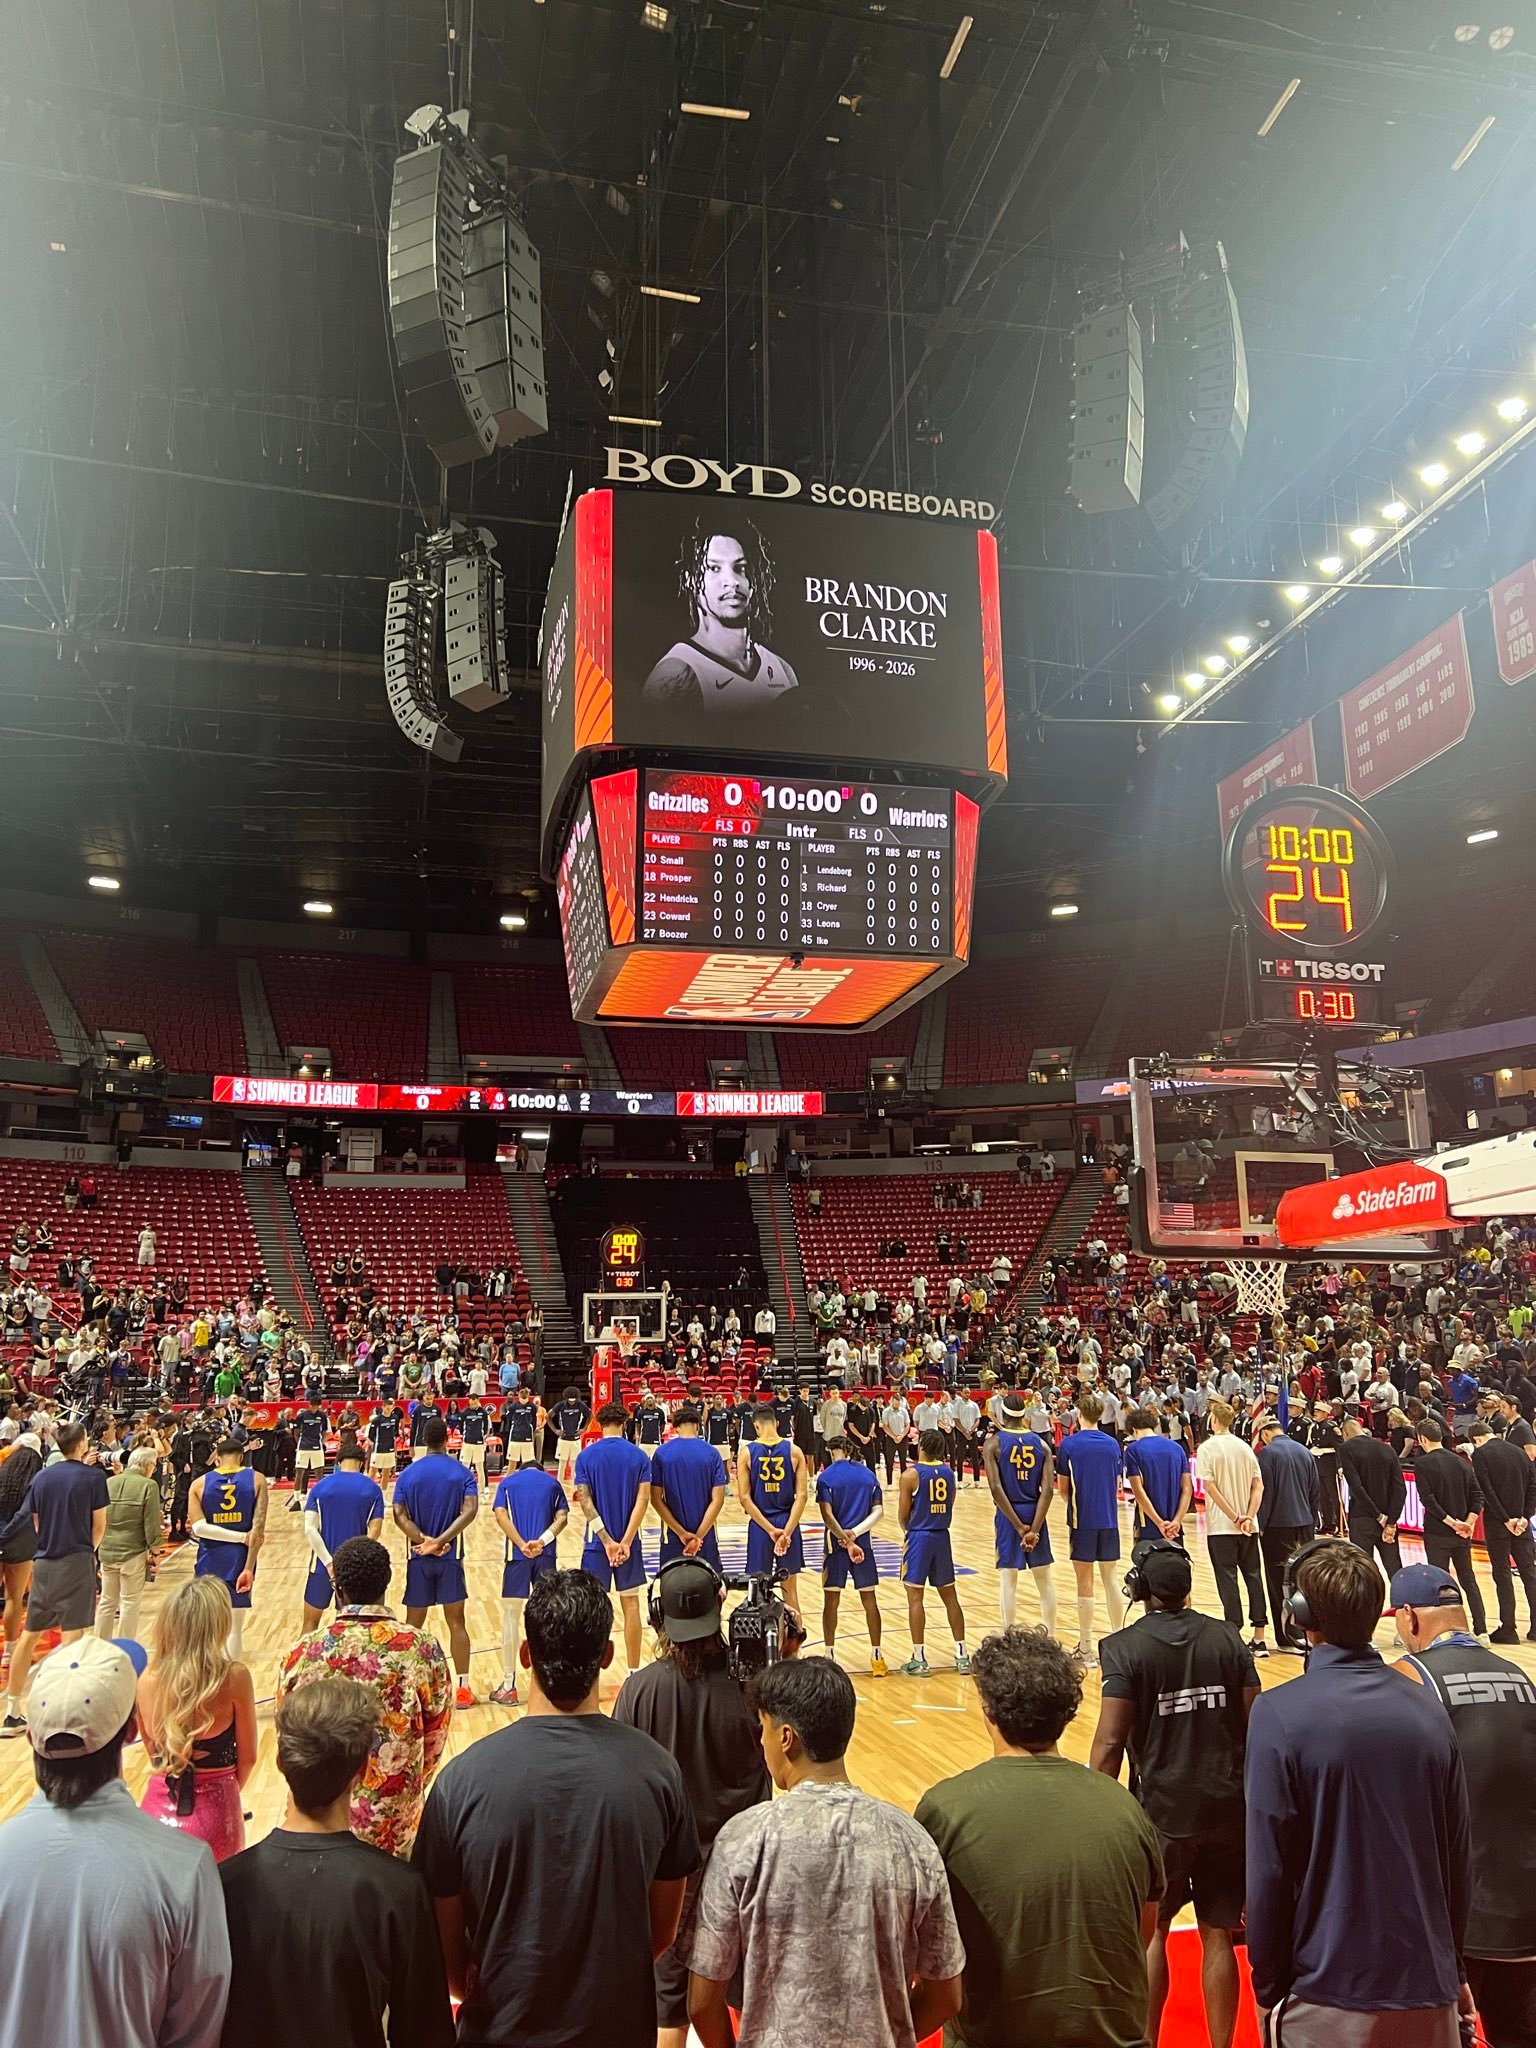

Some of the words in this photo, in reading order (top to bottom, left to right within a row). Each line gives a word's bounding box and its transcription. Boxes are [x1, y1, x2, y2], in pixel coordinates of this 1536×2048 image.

[603, 446, 801, 498] BOYD
[811, 483, 995, 521] SCOREBOARD
[805, 577, 947, 617] BRANDON
[820, 611, 937, 648] CLARKE
[1508, 632, 1533, 665] 1989
[849, 656, 875, 671] 1996
[886, 660, 915, 676] 2026
[649, 792, 709, 813] Grizzlies
[724, 783, 742, 806] 0
[762, 786, 842, 813] 10:00
[860, 793, 877, 815] 0
[889, 808, 948, 828] Warriors
[716, 820, 733, 831] FLS
[742, 821, 751, 834] 0
[787, 823, 817, 838] Intr
[849, 828, 866, 840] FLS
[875, 829, 883, 842] 0
[652, 834, 680, 844] PLAYER
[713, 838, 727, 847] PTS
[733, 839, 748, 848] RBS
[756, 841, 770, 849] AST
[777, 842, 790, 851] FLS
[1269, 825, 1353, 864] 10:00
[808, 843, 835, 853] PLAYER
[866, 847, 880, 856] PTS
[886, 848, 900, 857] RBS
[907, 850, 921, 858] AST
[928, 851, 940, 859] FLS
[645, 854, 656, 863] 10
[661, 856, 683, 865] Small
[715, 853, 723, 867] 0
[736, 855, 744, 868] 0
[758, 856, 766, 869] 0
[781, 857, 789, 870] 0
[803, 865, 808, 874] 1
[867, 862, 875, 875] 0
[889, 863, 896, 876] 0
[910, 864, 918, 877] 0
[932, 866, 940, 878] 0
[645, 872, 656, 881] 18
[660, 873, 692, 883] Prosper
[714, 871, 722, 884] 0
[736, 872, 744, 885] 0
[758, 874, 765, 886] 0
[781, 875, 789, 887] 0
[802, 883, 807, 892] 3
[817, 884, 847, 892] Richard
[867, 879, 875, 892] 0
[889, 881, 896, 893] 0
[910, 882, 917, 894] 0
[932, 883, 940, 895] 0
[644, 893, 655, 902] 22
[660, 894, 698, 904] Hendricks
[714, 890, 722, 902] 0
[736, 891, 744, 904] 0
[758, 892, 765, 905] 0
[781, 893, 789, 906] 0
[802, 901, 812, 910] 18
[817, 902, 837, 911] Cryer
[867, 898, 875, 910] 0
[888, 899, 896, 911] 0
[909, 900, 917, 913] 0
[932, 901, 940, 913] 0
[1266, 865, 1353, 933] 24
[644, 911, 656, 920] 23
[659, 911, 690, 921] Coward
[714, 908, 722, 920] 0
[735, 909, 744, 921] 0
[757, 910, 765, 923] 0
[780, 911, 788, 924] 0
[801, 919, 812, 928] 33
[817, 920, 840, 928] Leons
[867, 915, 875, 928] 0
[888, 916, 896, 929] 0
[909, 917, 917, 930] 0
[931, 918, 939, 931] 0
[339, 930, 357, 940] 217
[644, 929, 655, 938] 27
[659, 929, 688, 939] Boozer
[714, 925, 722, 938] 0
[735, 926, 743, 939] 0
[757, 927, 765, 940] 0
[780, 929, 788, 941] 0
[801, 935, 812, 944] 45
[817, 937, 828, 945] Ike
[867, 932, 875, 945] 0
[888, 933, 896, 946] 0
[909, 934, 917, 947] 0
[931, 935, 939, 948] 0
[1295, 960, 1385, 981] TISSOT
[1299, 990, 1355, 1020] 0:30
[249, 1080, 306, 1104] SUMMER
[309, 1083, 359, 1106] LEAGUE
[402, 1085, 442, 1094] Grizzlies
[470, 1091, 480, 1102] 2
[496, 1092, 504, 1102] 0
[616, 1091, 653, 1100] Warriors
[416, 1095, 429, 1109] 0
[508, 1094, 555, 1108] 10:00
[559, 1094, 567, 1104] 0
[580, 1093, 590, 1105] 2
[627, 1099, 640, 1114] 0
[707, 1094, 758, 1113] SUMMER
[761, 1094, 805, 1113] LEAGUE
[64, 1147, 85, 1160] 110
[925, 1161, 943, 1171] 113
[613, 1234, 637, 1246] 10:00
[611, 1246, 635, 1264] 24
[616, 1278, 633, 1287] 0:30
[1010, 1446, 1035, 1469] 45
[759, 1457, 785, 1480] 33
[220, 1485, 236, 1510] 3
[930, 1478, 947, 1502] 18
[1443, 1672, 1536, 1706] ESPN
[1158, 1686, 1226, 1717] ESPN
